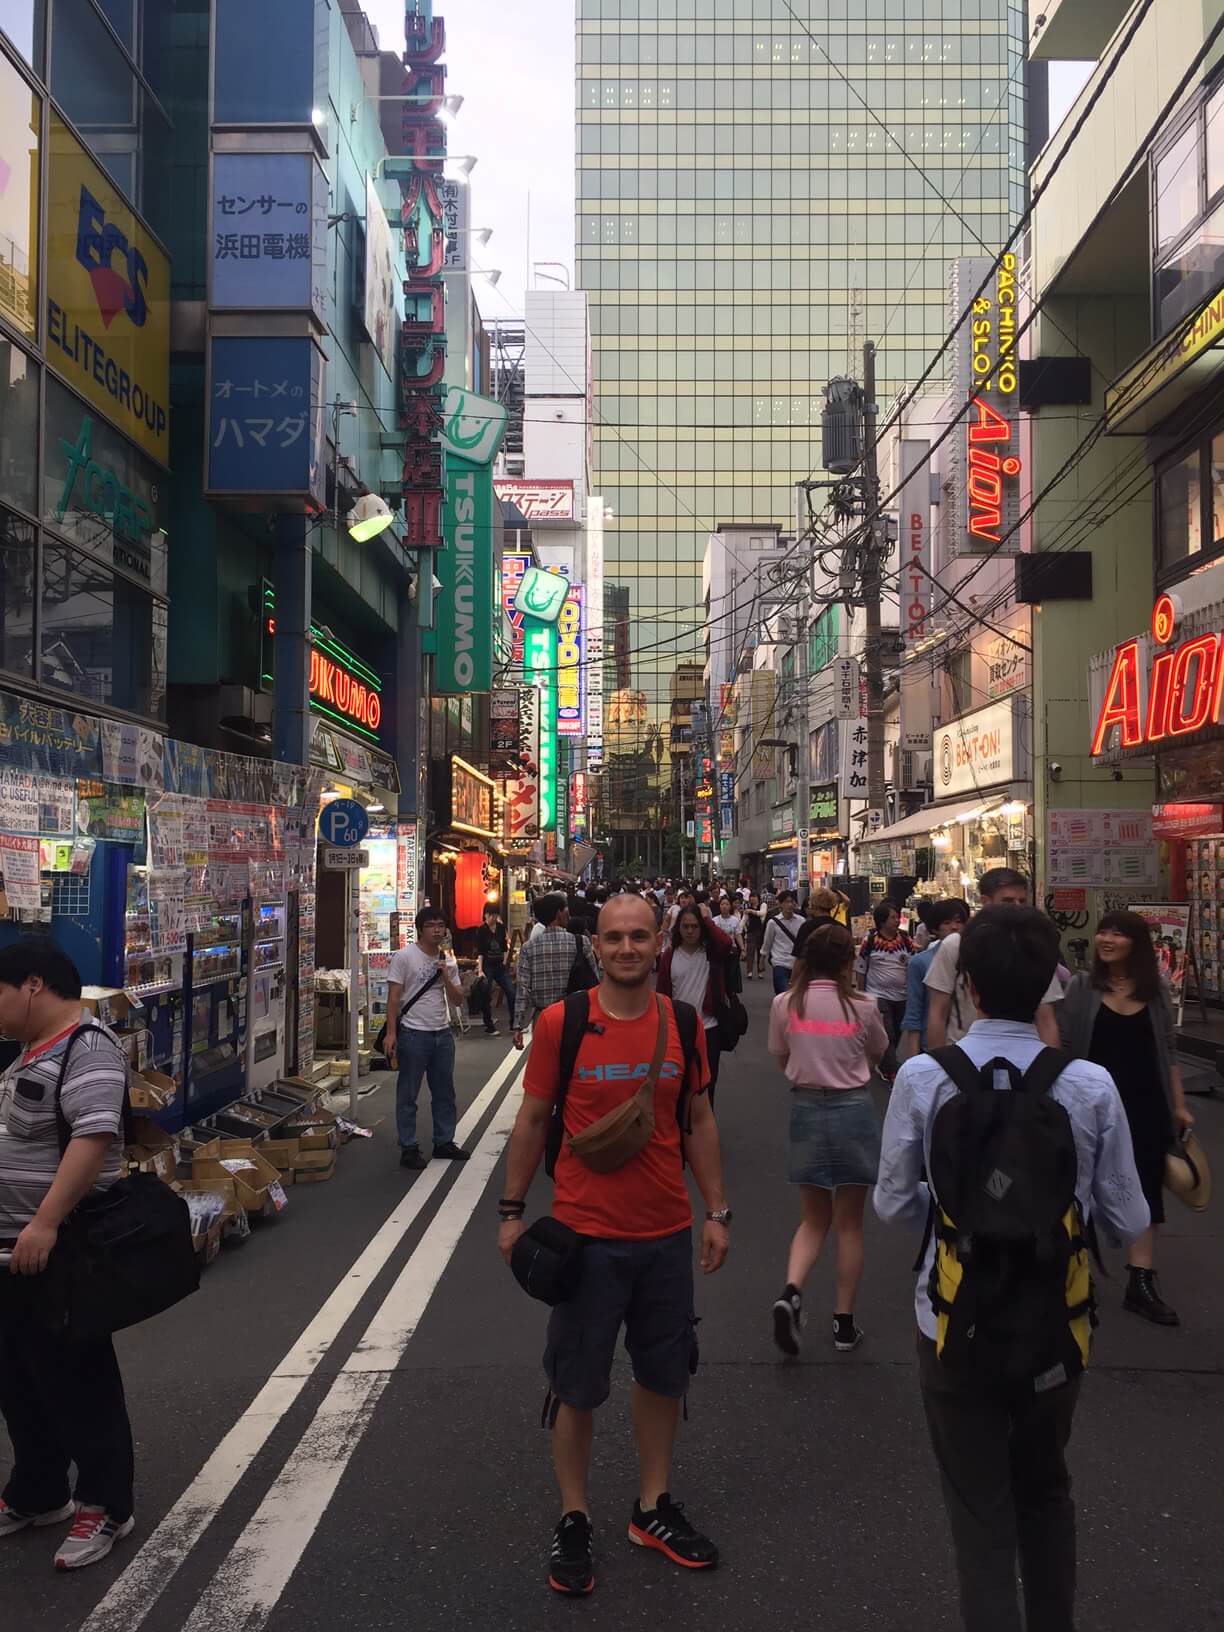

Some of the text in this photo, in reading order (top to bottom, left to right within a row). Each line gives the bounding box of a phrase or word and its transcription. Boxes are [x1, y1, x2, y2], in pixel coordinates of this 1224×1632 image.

[217, 195, 308, 217] センサーの
[75, 183, 149, 329] ECS
[214, 232, 311, 261] 浜田電機
[47, 303, 167, 441] ELITEGROUP
[215, 379, 304, 400] オートメの
[214, 410, 308, 449] ハマダ
[454, 471, 475, 687] TSUKUMO
[331, 811, 350, 842] P
[406, 836, 414, 849] TAX
[406, 851, 414, 870] FREE
[406, 871, 414, 891] SHOP
[577, 1061, 680, 1082] HEAD
